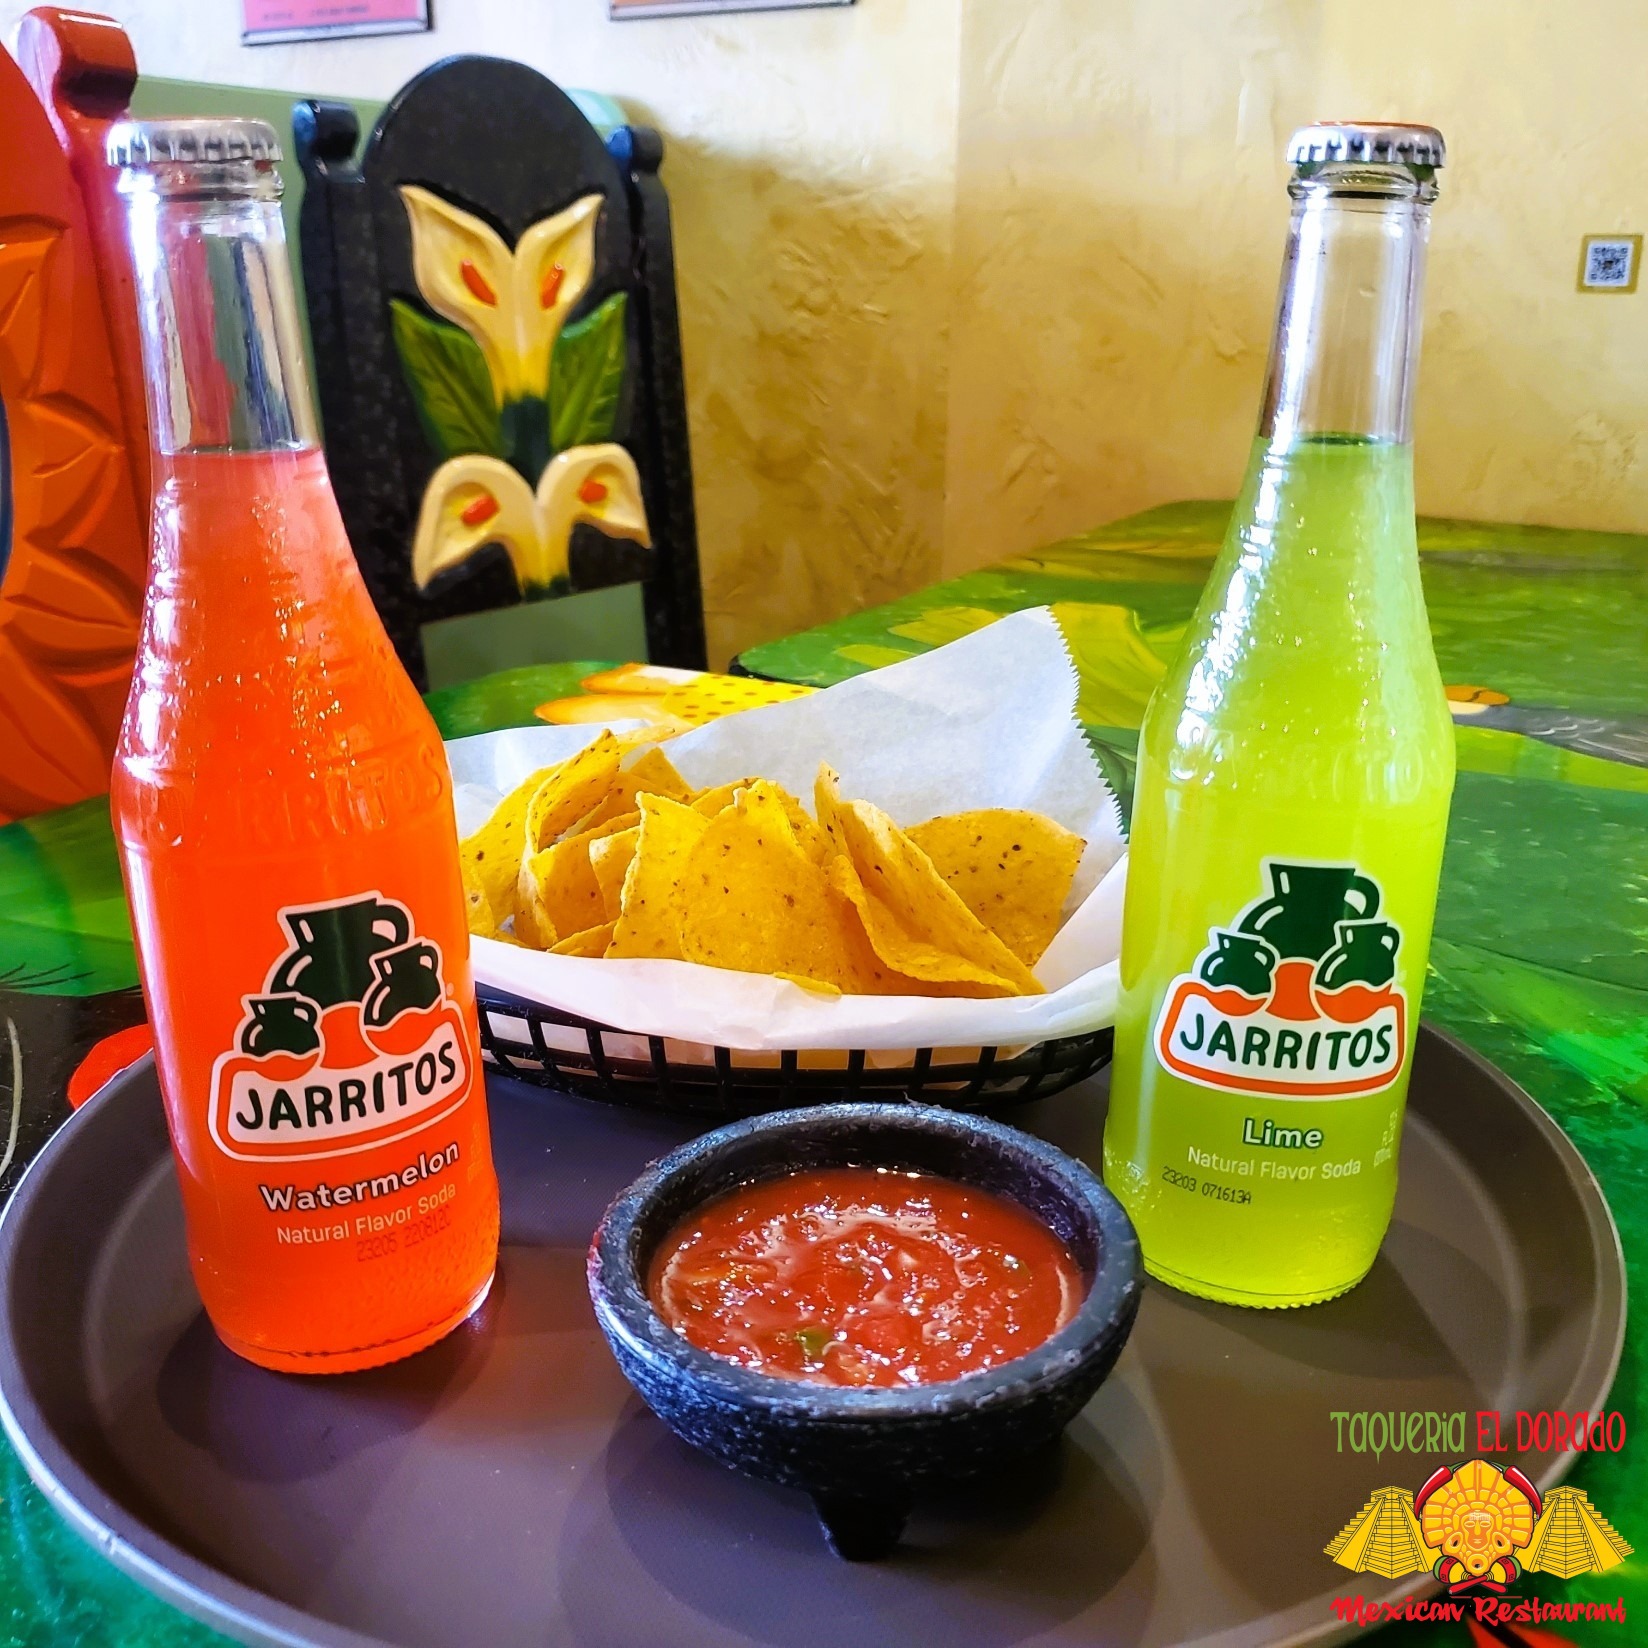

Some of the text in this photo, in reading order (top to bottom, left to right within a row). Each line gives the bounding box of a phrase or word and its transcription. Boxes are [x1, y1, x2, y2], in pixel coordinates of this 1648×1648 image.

[1180, 1013, 1392, 1071] JARRITOS
[236, 1041, 456, 1130] JARRITOS
[1243, 1118, 1324, 1149] Lime
[259, 1142, 460, 1212] Watermelon
[1161, 1165, 1252, 1205] 23203 071613A
[1187, 1146, 1362, 1181] Natural Flavor Soda
[277, 1183, 457, 1245] Natural Flavor Soda
